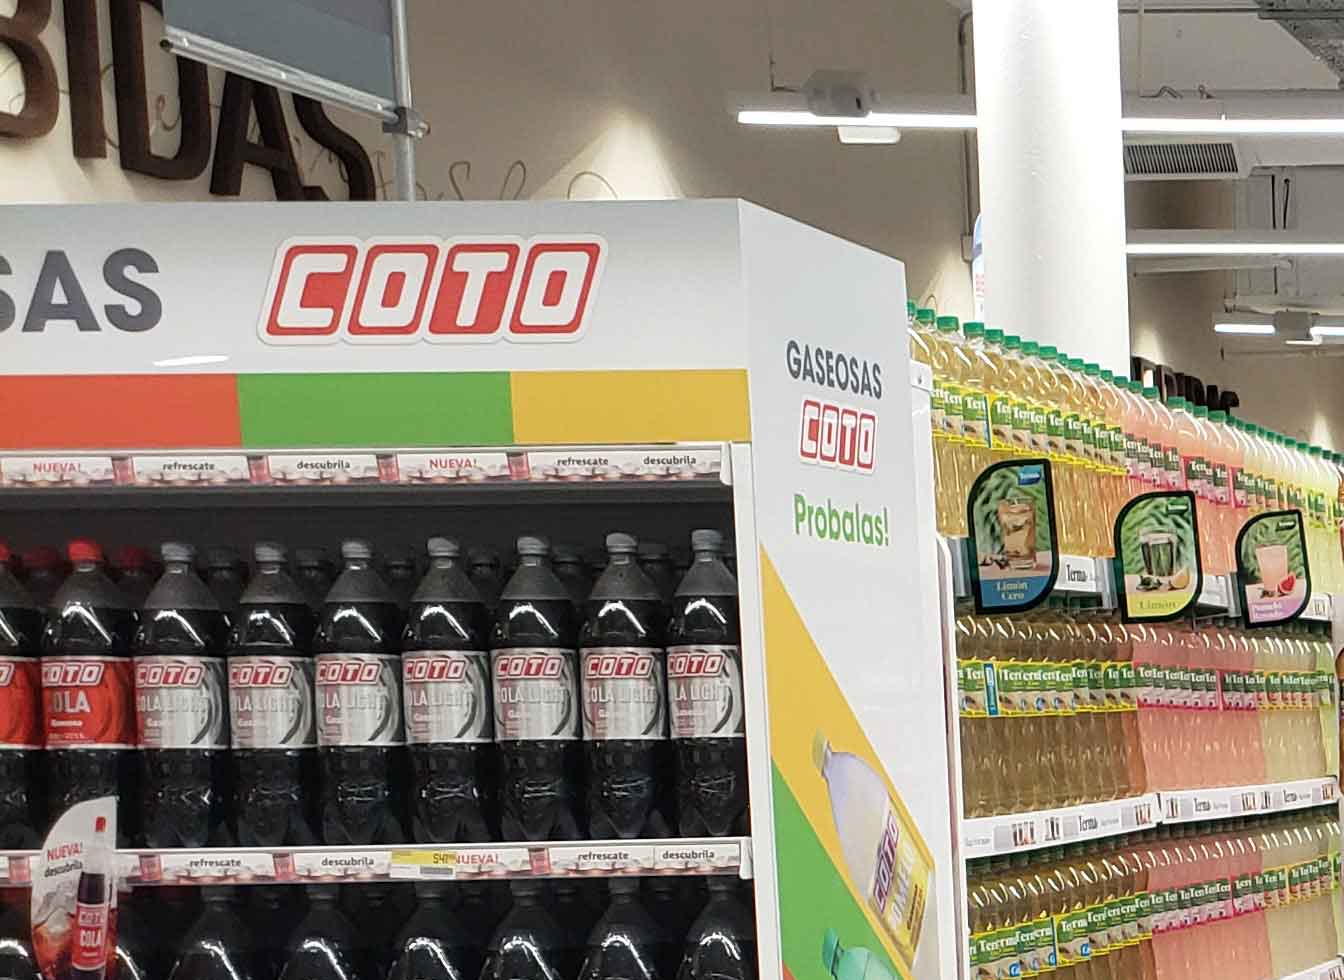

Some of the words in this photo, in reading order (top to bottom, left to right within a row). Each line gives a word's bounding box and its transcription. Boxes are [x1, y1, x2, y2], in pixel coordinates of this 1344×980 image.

[263, 240, 605, 342] COTO
[786, 340, 883, 401] GASEOSAS
[800, 400, 877, 475] COTO
[32, 460, 82, 474] NUEVA!
[162, 460, 216, 473] refrescate
[296, 459, 352, 471] descubrila
[428, 457, 478, 470] NUEVA!
[556, 456, 610, 468] refrescate
[642, 455, 697, 467] descubrila
[794, 494, 890, 547] Probalas!
[497, 656, 564, 680] COTO
[586, 655, 654, 679] COTO
[46, 842, 84, 862] NUEVA!
[188, 855, 242, 869] refrescate
[321, 855, 375, 868] descubrila
[455, 853, 499, 866] NUEVA!
[577, 850, 630, 863] refrescate
[662, 848, 716, 862] descubrila
[872, 812, 900, 914] COTO
